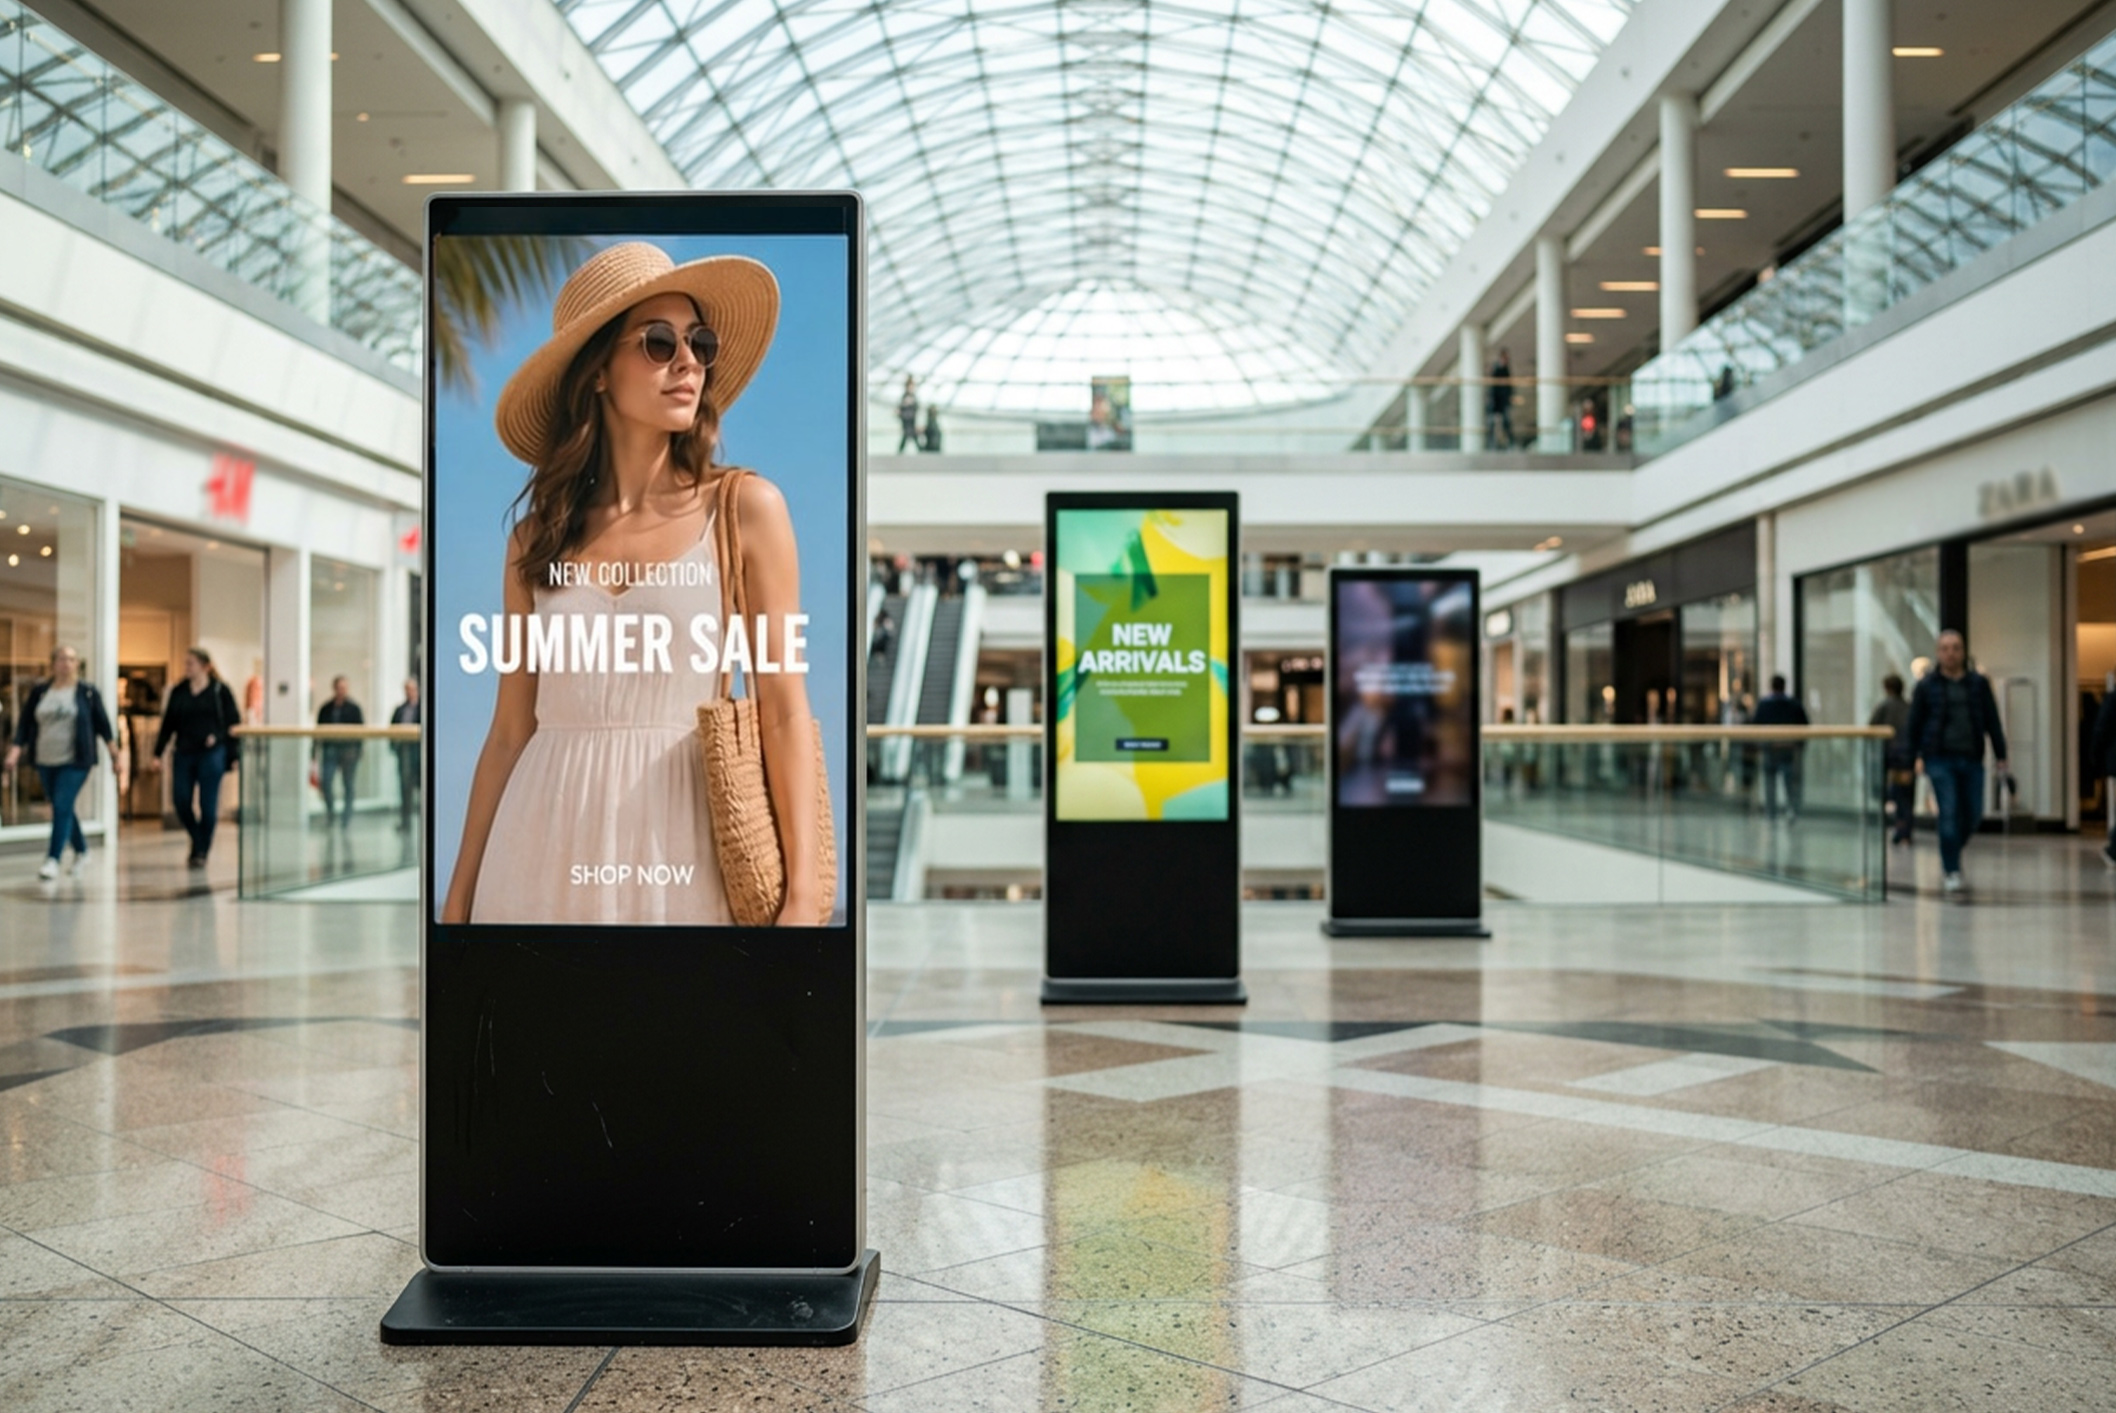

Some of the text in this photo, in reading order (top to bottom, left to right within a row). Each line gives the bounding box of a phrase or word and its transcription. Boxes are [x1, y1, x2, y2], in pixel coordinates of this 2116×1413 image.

[549, 562, 712, 586] NEW COLLECTION
[459, 613, 810, 674] SUMMER SALE
[1112, 623, 1172, 647] NEW
[1078, 650, 1206, 674] ARRIVALS
[570, 864, 695, 885] SHOP NOW
